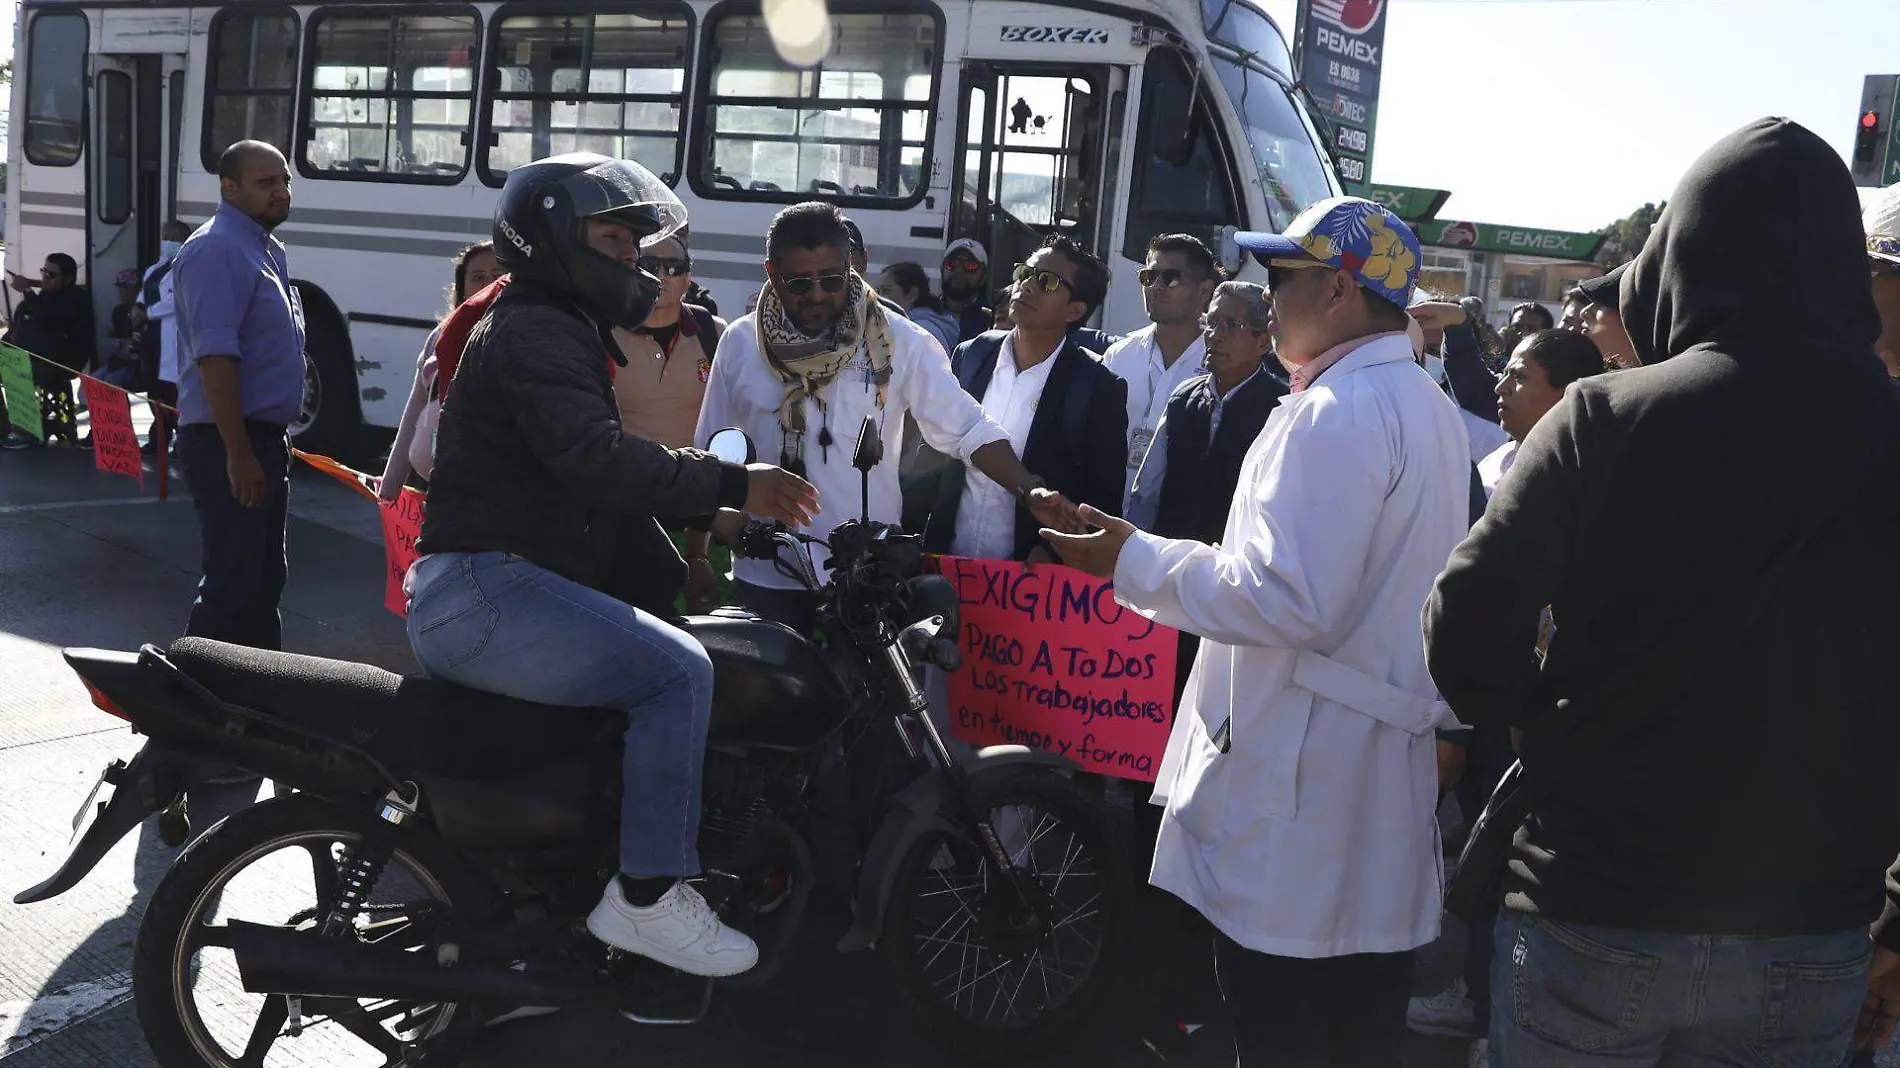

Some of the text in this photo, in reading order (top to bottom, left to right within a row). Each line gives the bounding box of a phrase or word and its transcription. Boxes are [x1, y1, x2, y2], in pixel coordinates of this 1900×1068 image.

[1001, 26, 1108, 43] BOXER
[1316, 26, 1378, 66] PEMEX
[1496, 229, 1570, 250] PEMEX
[966, 622, 1024, 666] PAGO
[1030, 640, 1053, 676] A
[958, 705, 985, 729] en
[1058, 739, 1072, 756] y
[1076, 733, 1153, 776] forma
